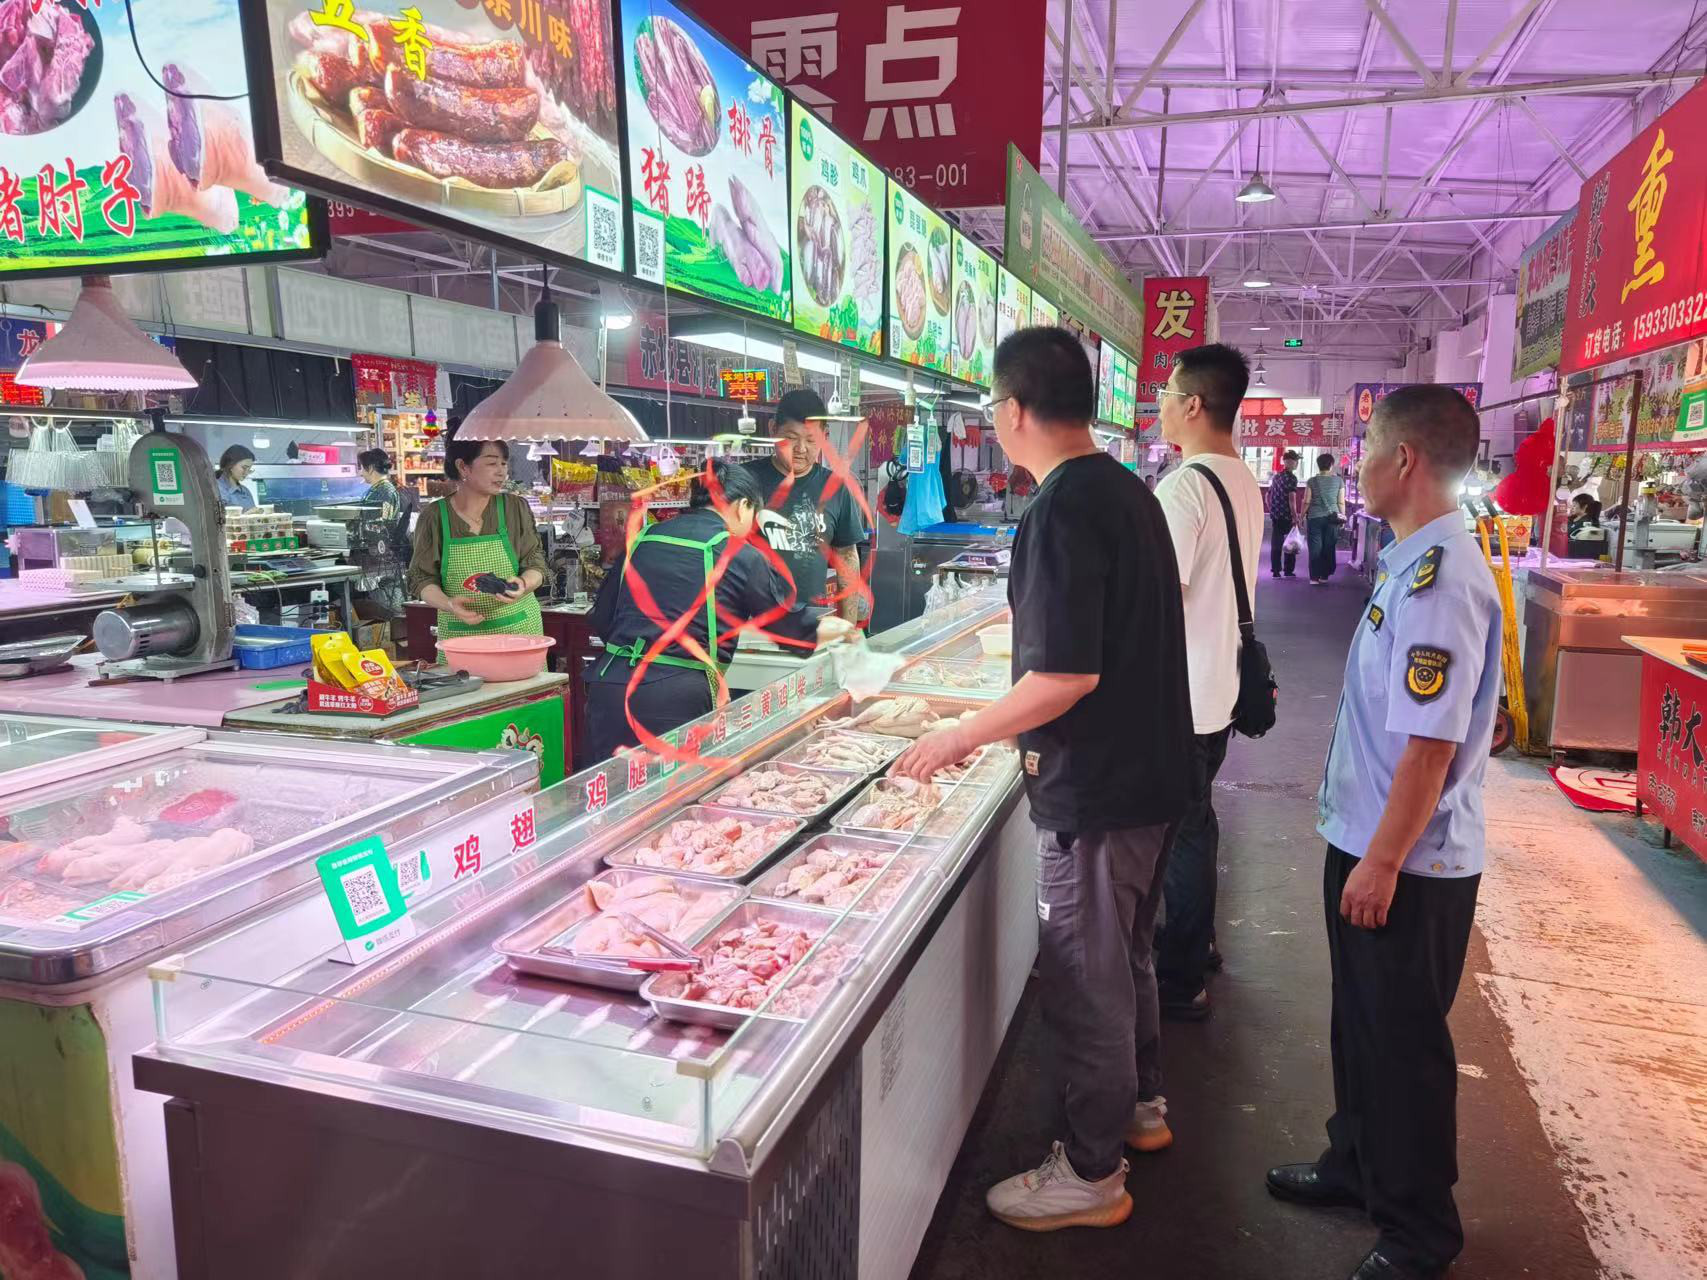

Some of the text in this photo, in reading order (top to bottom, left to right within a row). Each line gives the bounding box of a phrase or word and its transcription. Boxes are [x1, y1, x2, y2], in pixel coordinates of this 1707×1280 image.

[727, 99, 776, 181] 排骨
[640, 147, 714, 237] 猪蹄
[1151, 289, 1196, 340] 发
[452, 808, 536, 880] 鸡翅
